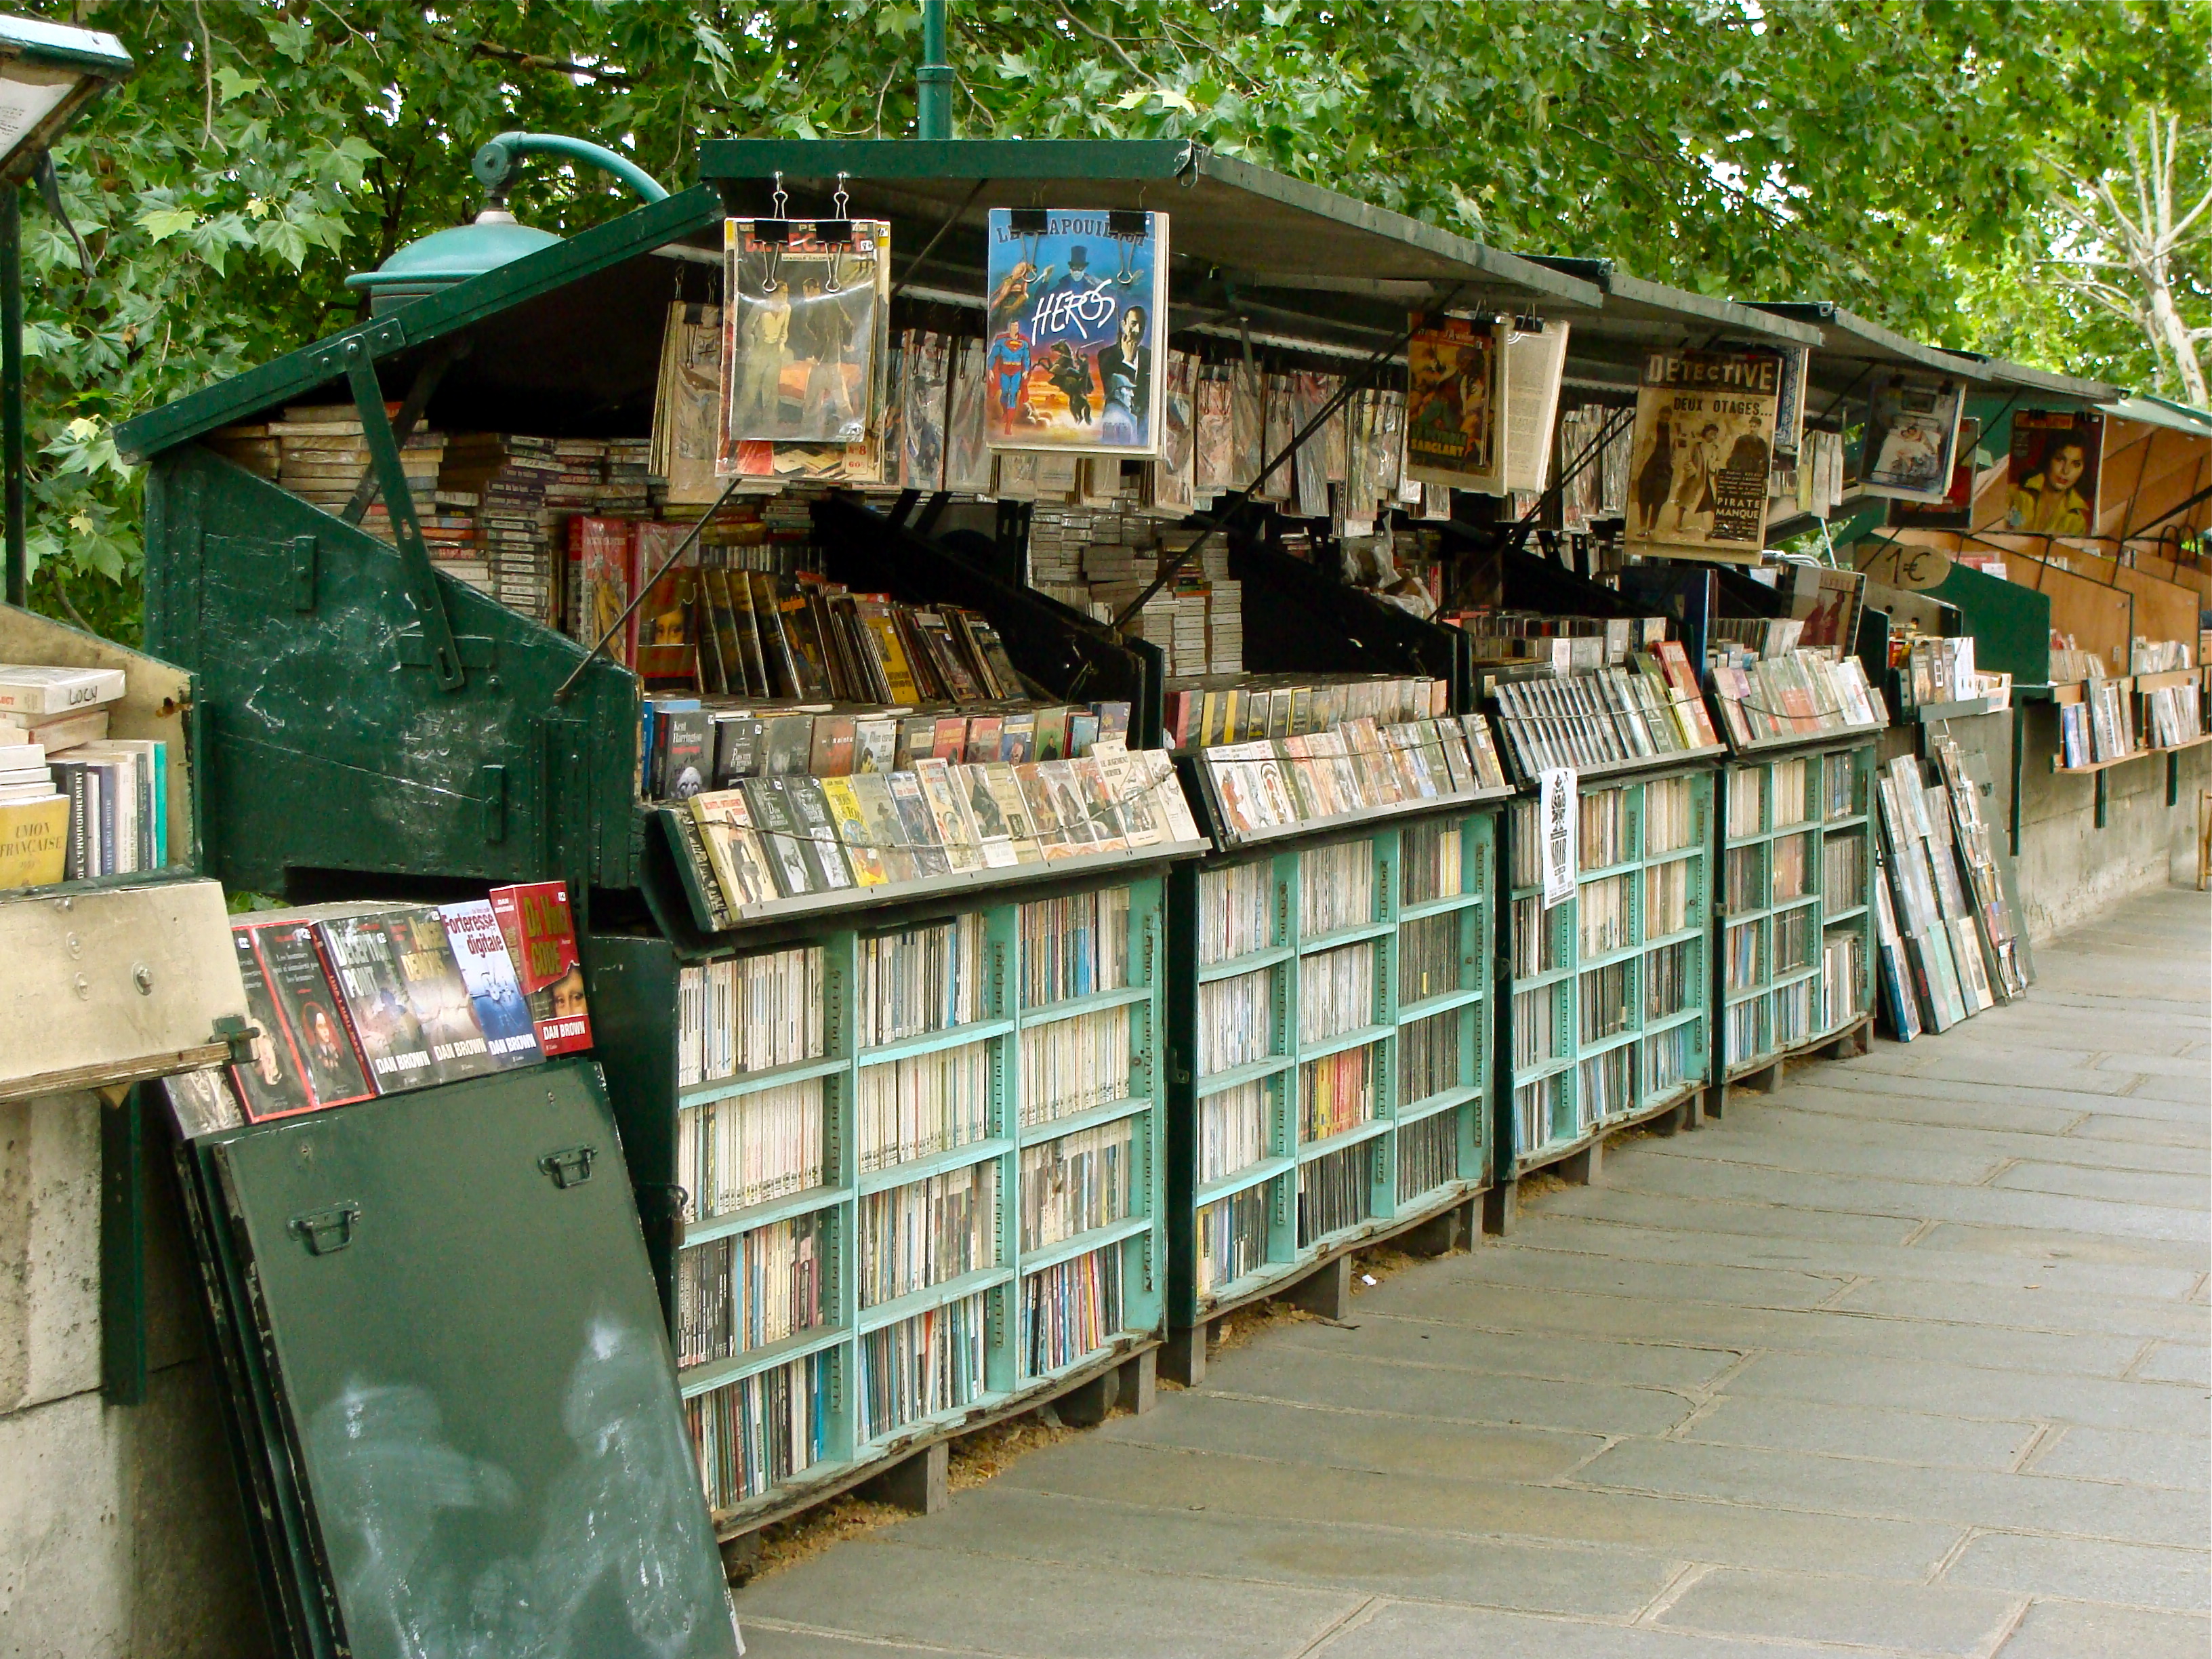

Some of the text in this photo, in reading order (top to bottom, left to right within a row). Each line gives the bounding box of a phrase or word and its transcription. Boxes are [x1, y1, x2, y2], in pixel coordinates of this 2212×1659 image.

[1031, 279, 1115, 346] HEROS
[1648, 354, 1774, 390] DETECTIVE
[1673, 397, 1704, 412] DEUX
[859, 445, 866, 455] 8
[1717, 497, 1761, 509] PIRATE
[1885, 548, 1931, 583] 1€
[76, 771, 85, 863] L'ENVIRONNEMENT
[16, 821, 50, 839] UNION
[0, 836, 62, 858] FRANÇAISE
[442, 913, 495, 935] Forteresse
[467, 932, 504, 958] digitale
[543, 1021, 586, 1040] DAN BROWN
[433, 1038, 487, 1061] DAN BROWN
[488, 1038, 507, 1055] DAN
[508, 1033, 536, 1052] BROWN
[375, 1050, 431, 1074] DAN BROWN
